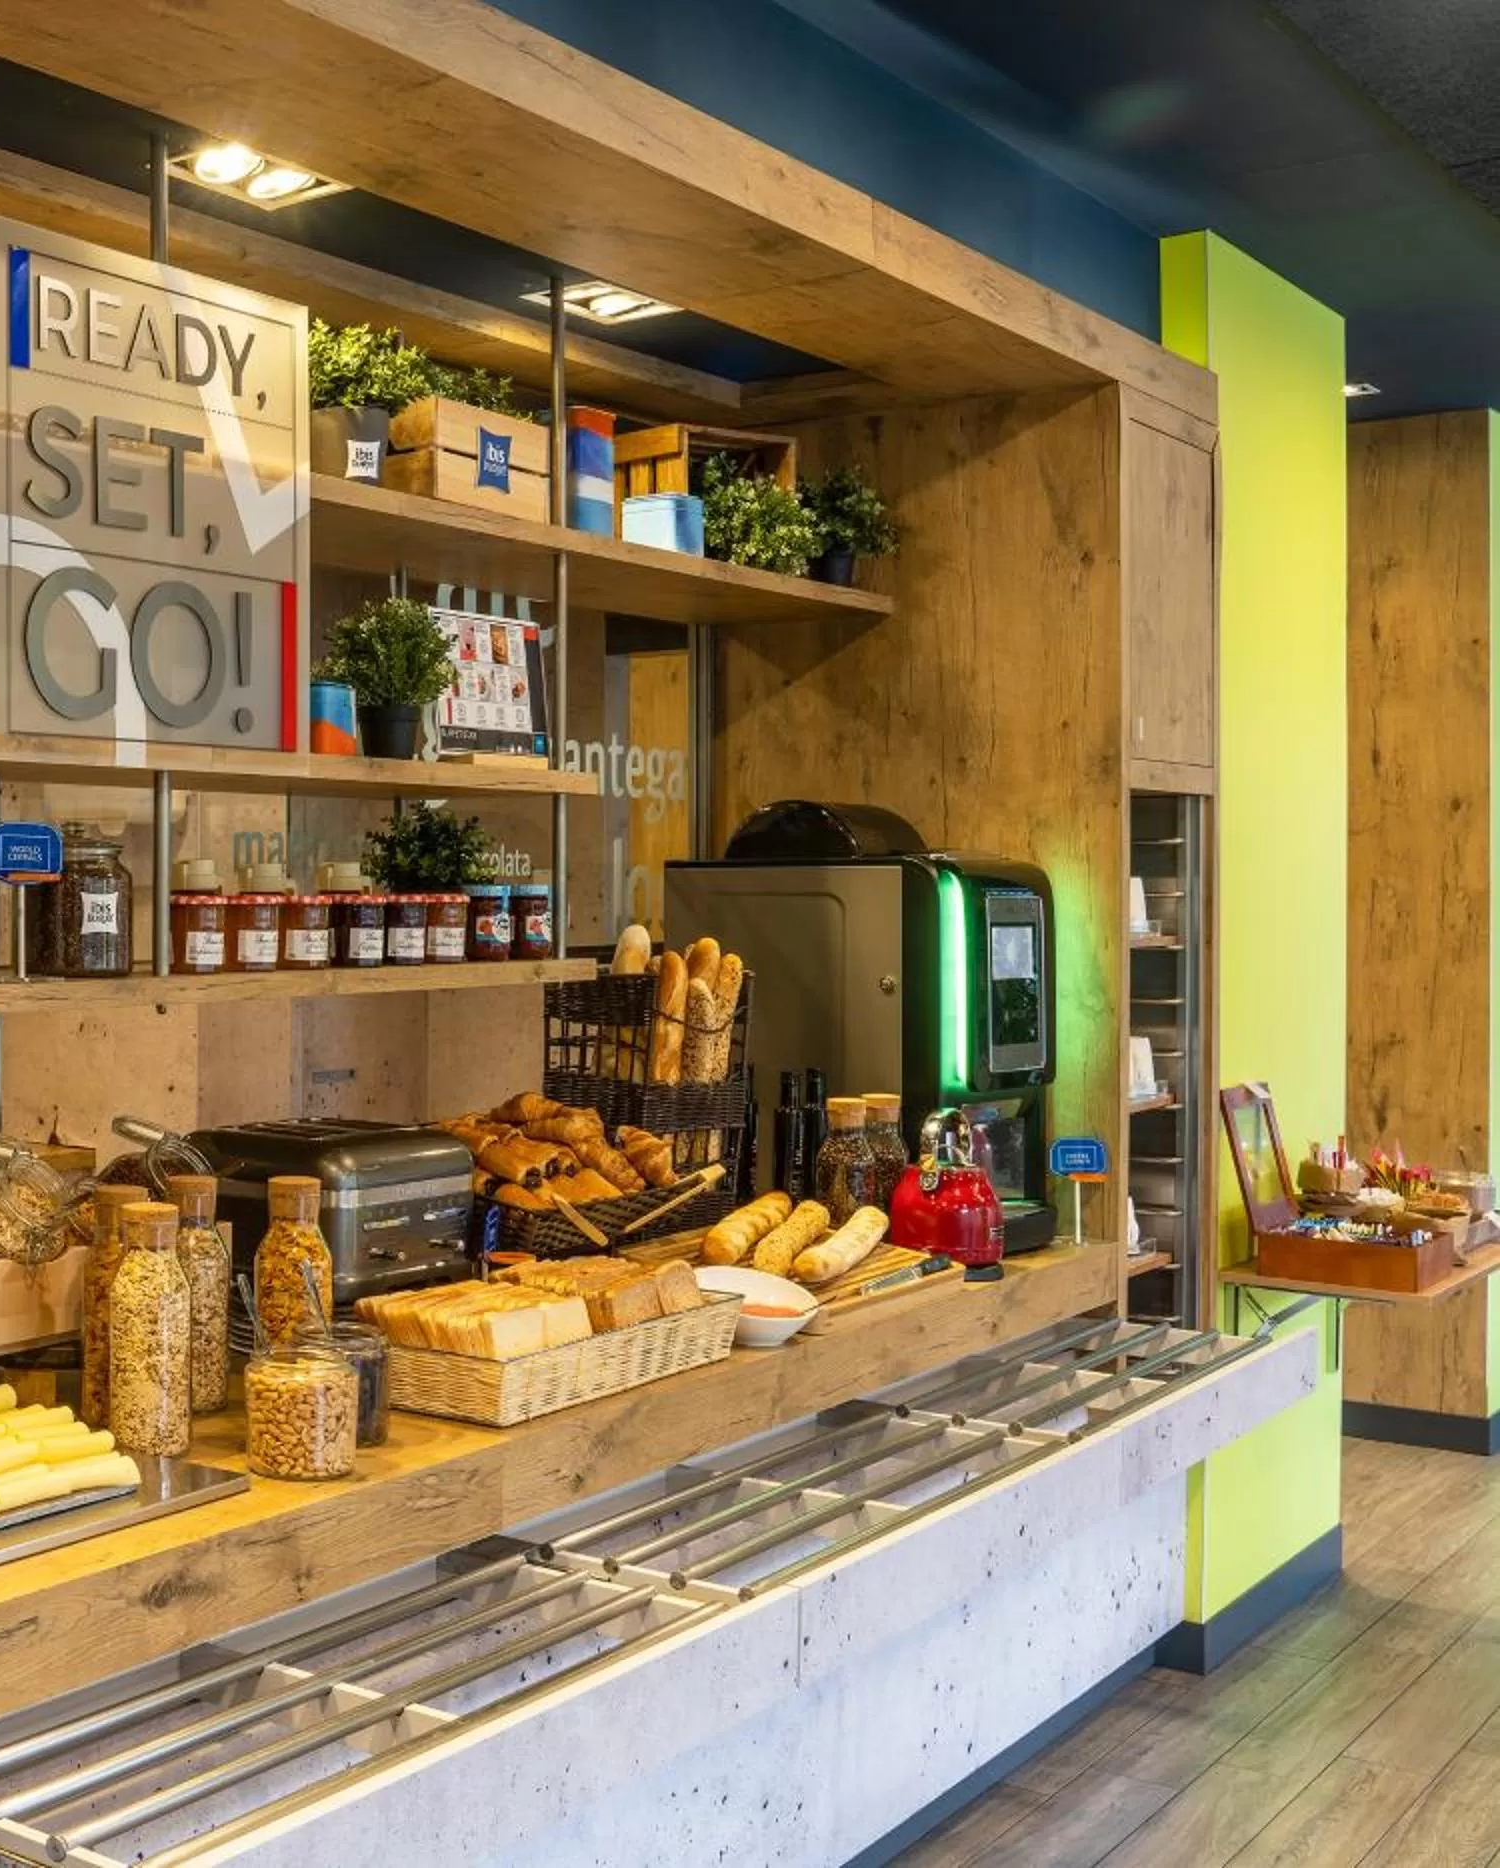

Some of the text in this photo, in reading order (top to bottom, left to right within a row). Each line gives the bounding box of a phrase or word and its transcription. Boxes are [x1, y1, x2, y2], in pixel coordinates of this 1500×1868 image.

[37, 274, 267, 411] READY,
[22, 404, 220, 555] SET,
[23, 565, 255, 734] GO!
[565, 731, 686, 823] antega
[90, 900, 112, 913] ibis
